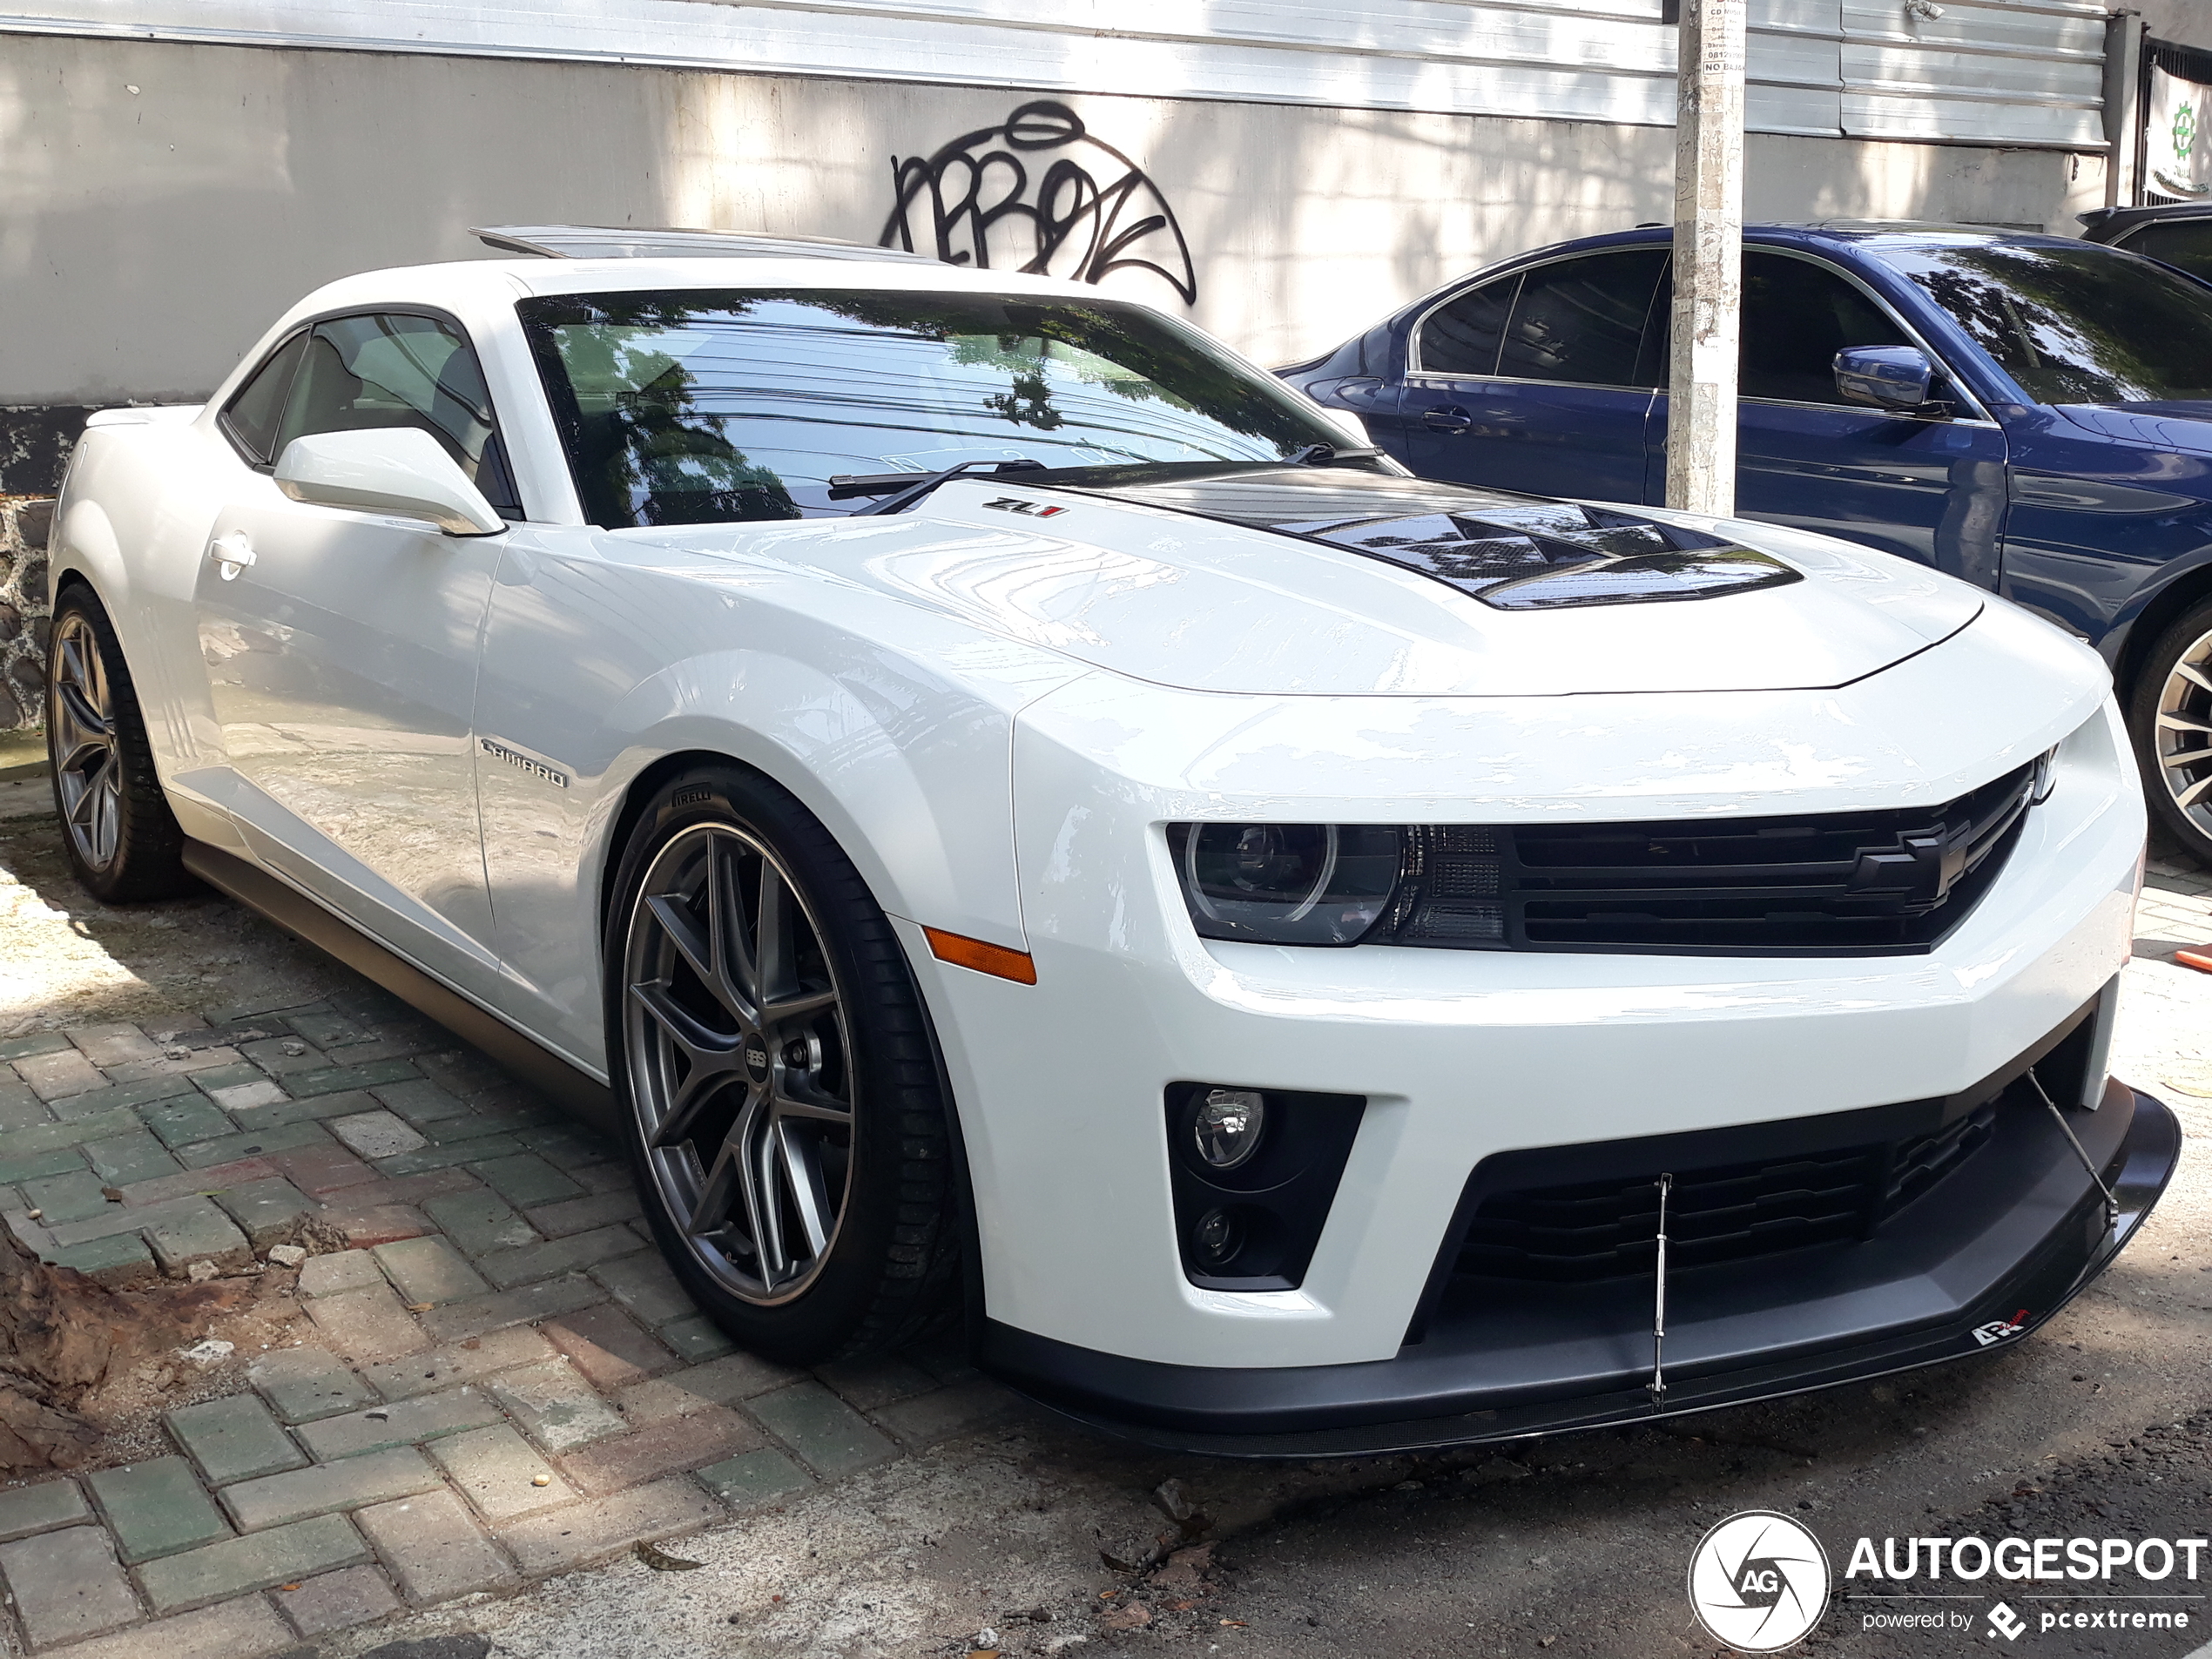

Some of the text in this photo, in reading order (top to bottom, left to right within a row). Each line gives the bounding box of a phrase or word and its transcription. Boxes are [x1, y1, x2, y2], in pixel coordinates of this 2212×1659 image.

[981, 496, 1071, 518] ZL1
[480, 738, 569, 788] CAMARO
[746, 1049, 767, 1069] BBS
